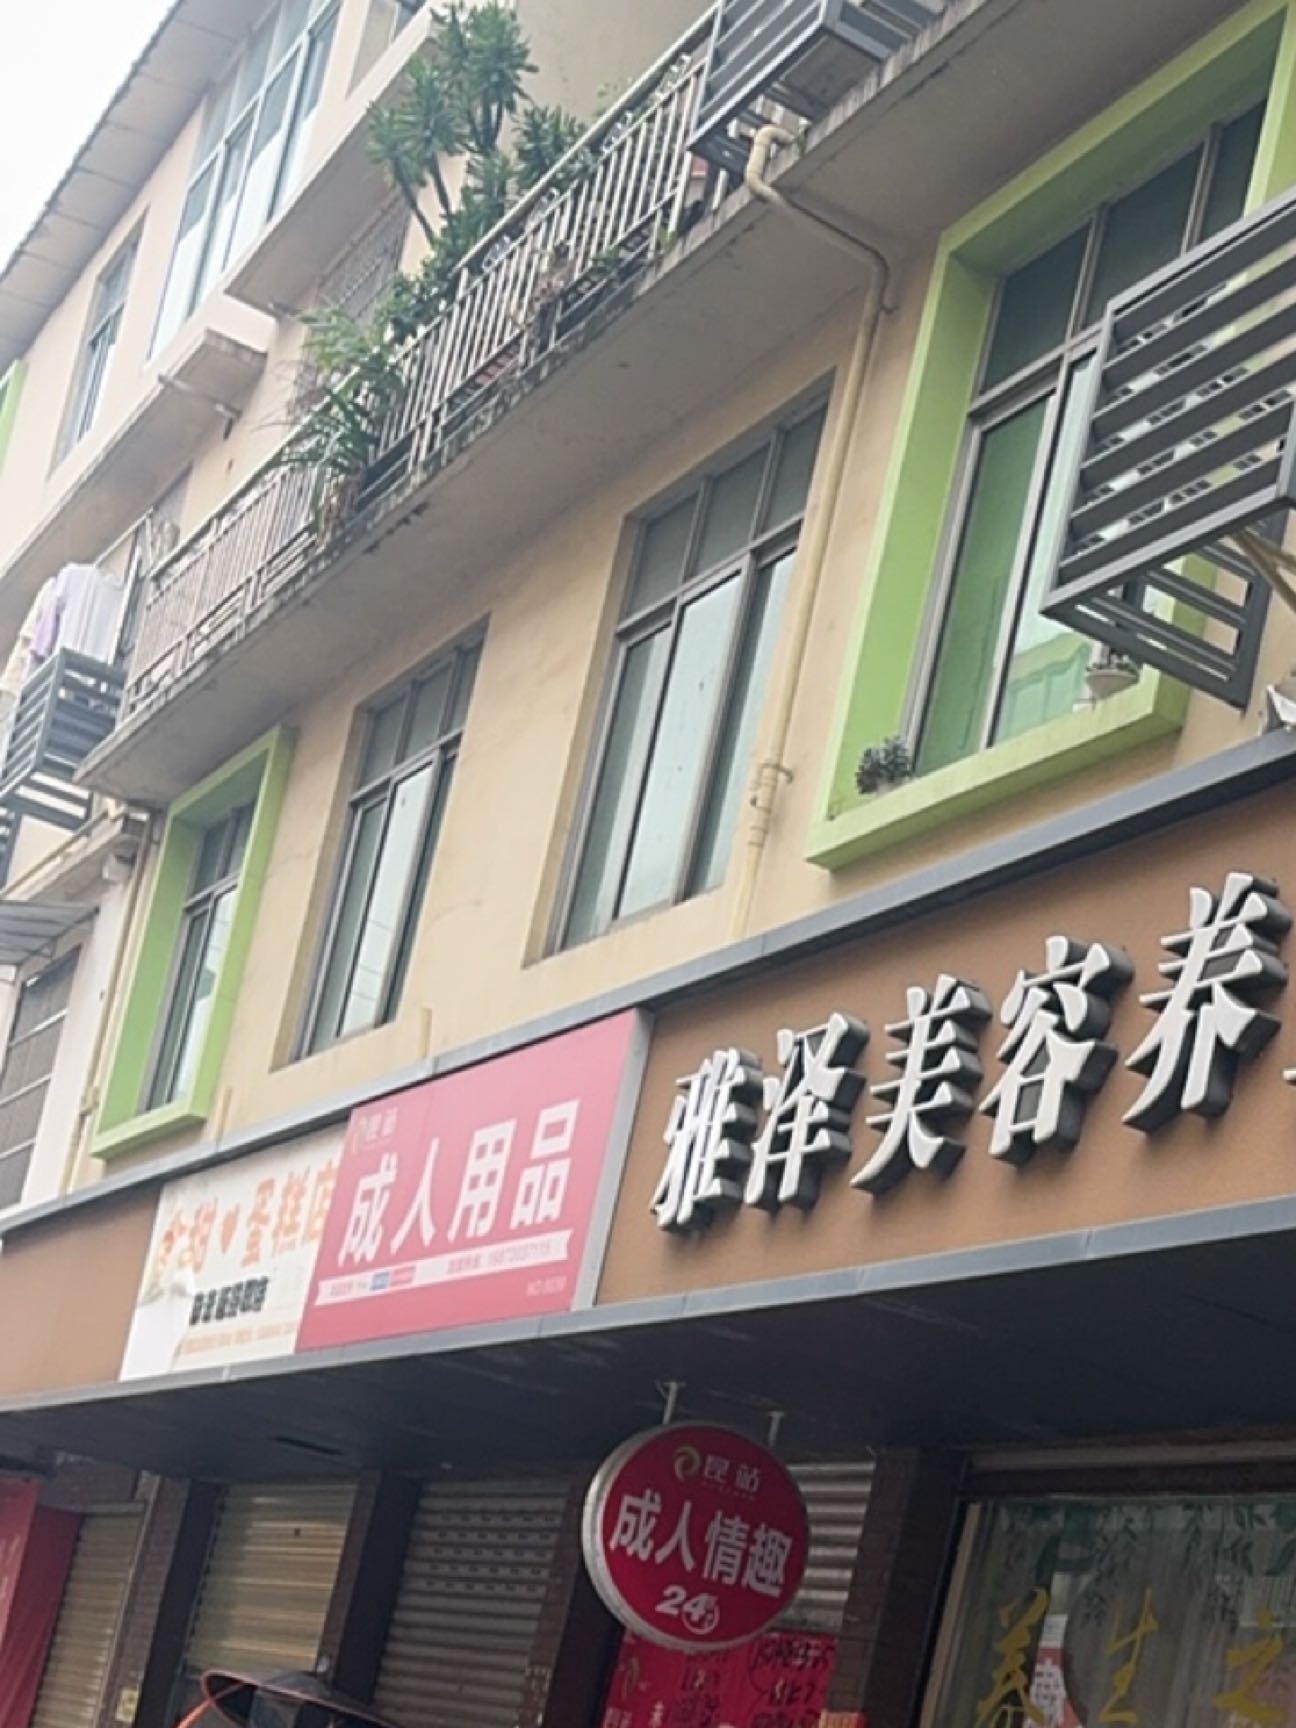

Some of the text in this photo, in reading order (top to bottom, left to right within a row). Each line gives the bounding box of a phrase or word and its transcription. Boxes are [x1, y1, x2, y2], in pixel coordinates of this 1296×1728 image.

[338, 1099, 580, 1268] 成人用品
[609, 1488, 793, 1598] 成人情趣
